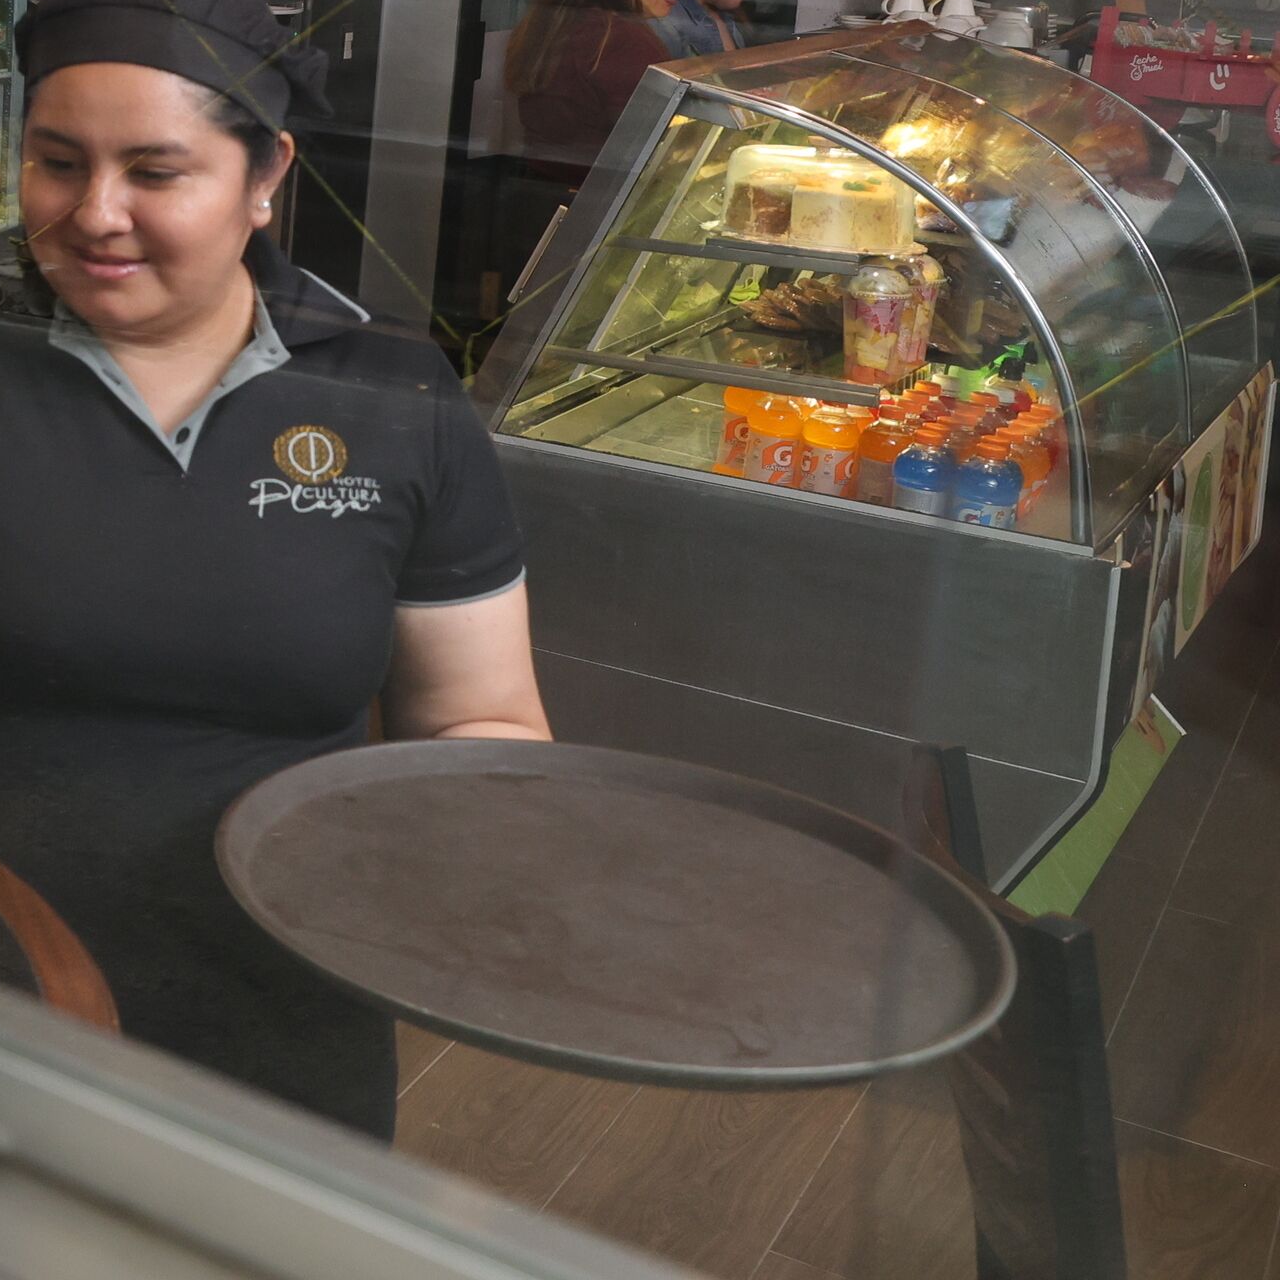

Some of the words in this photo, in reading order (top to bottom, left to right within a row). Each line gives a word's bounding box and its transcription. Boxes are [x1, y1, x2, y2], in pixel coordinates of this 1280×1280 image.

[333, 477, 381, 489] HOTEL
[248, 478, 373, 518] Plaza
[302, 486, 382, 504] CULTURA
